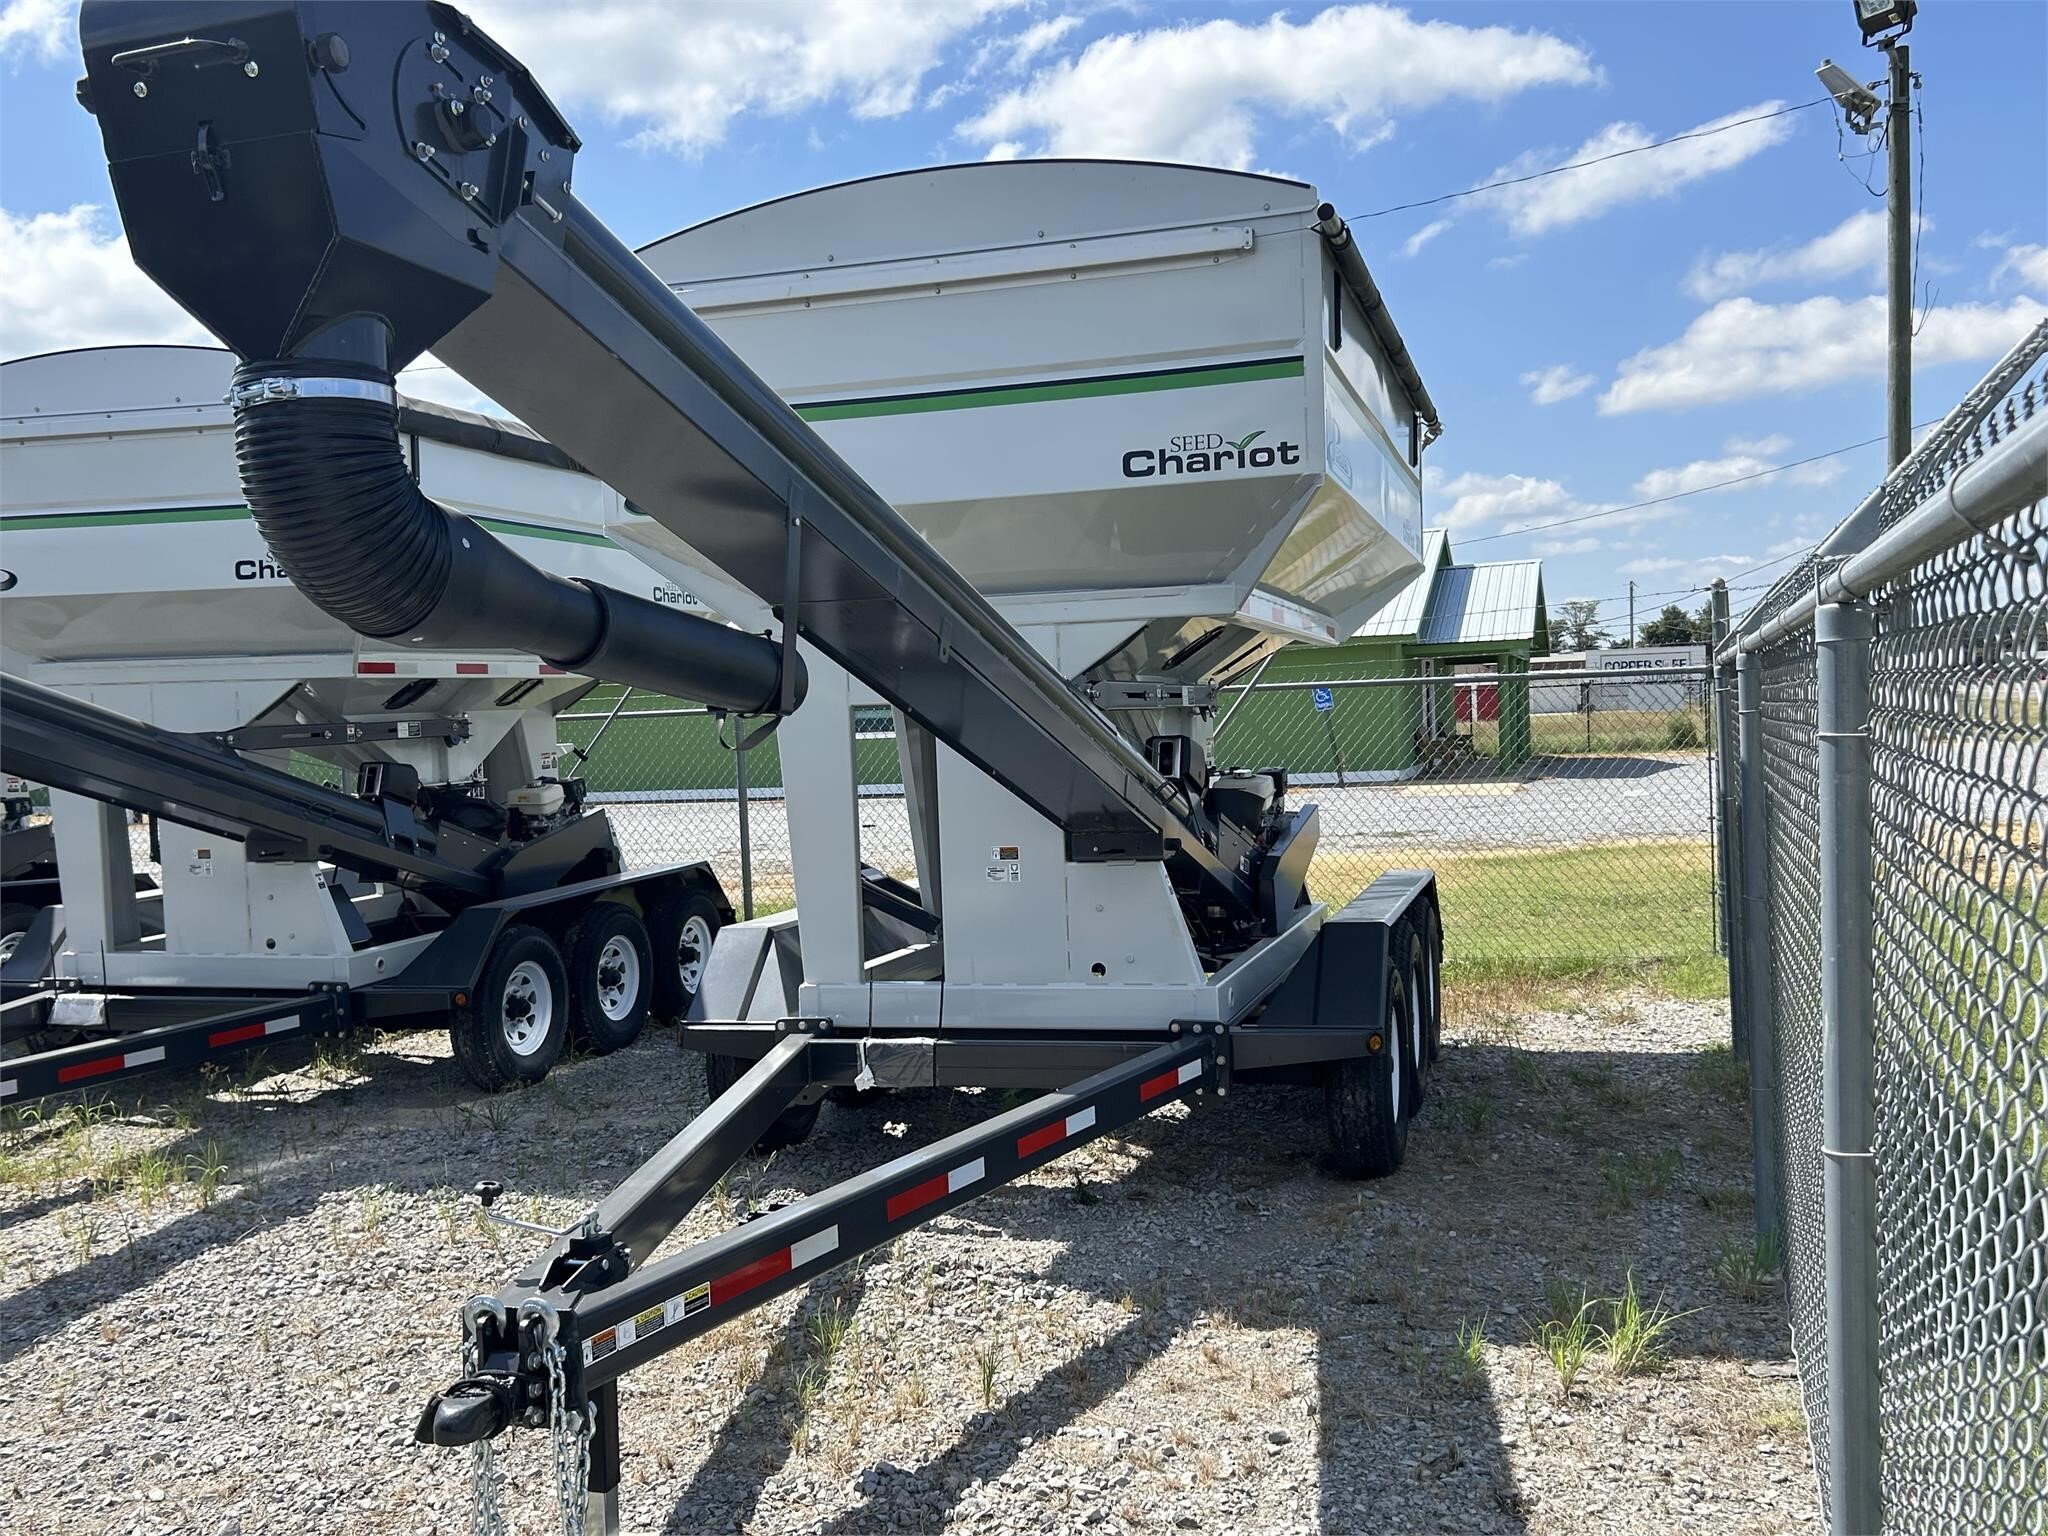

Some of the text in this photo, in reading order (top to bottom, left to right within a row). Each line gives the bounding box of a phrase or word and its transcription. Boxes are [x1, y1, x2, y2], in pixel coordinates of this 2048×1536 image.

[1170, 433, 1223, 453] SEED
[1122, 441, 1300, 478] Chariot
[639, 1307, 662, 1323] CAUTION
